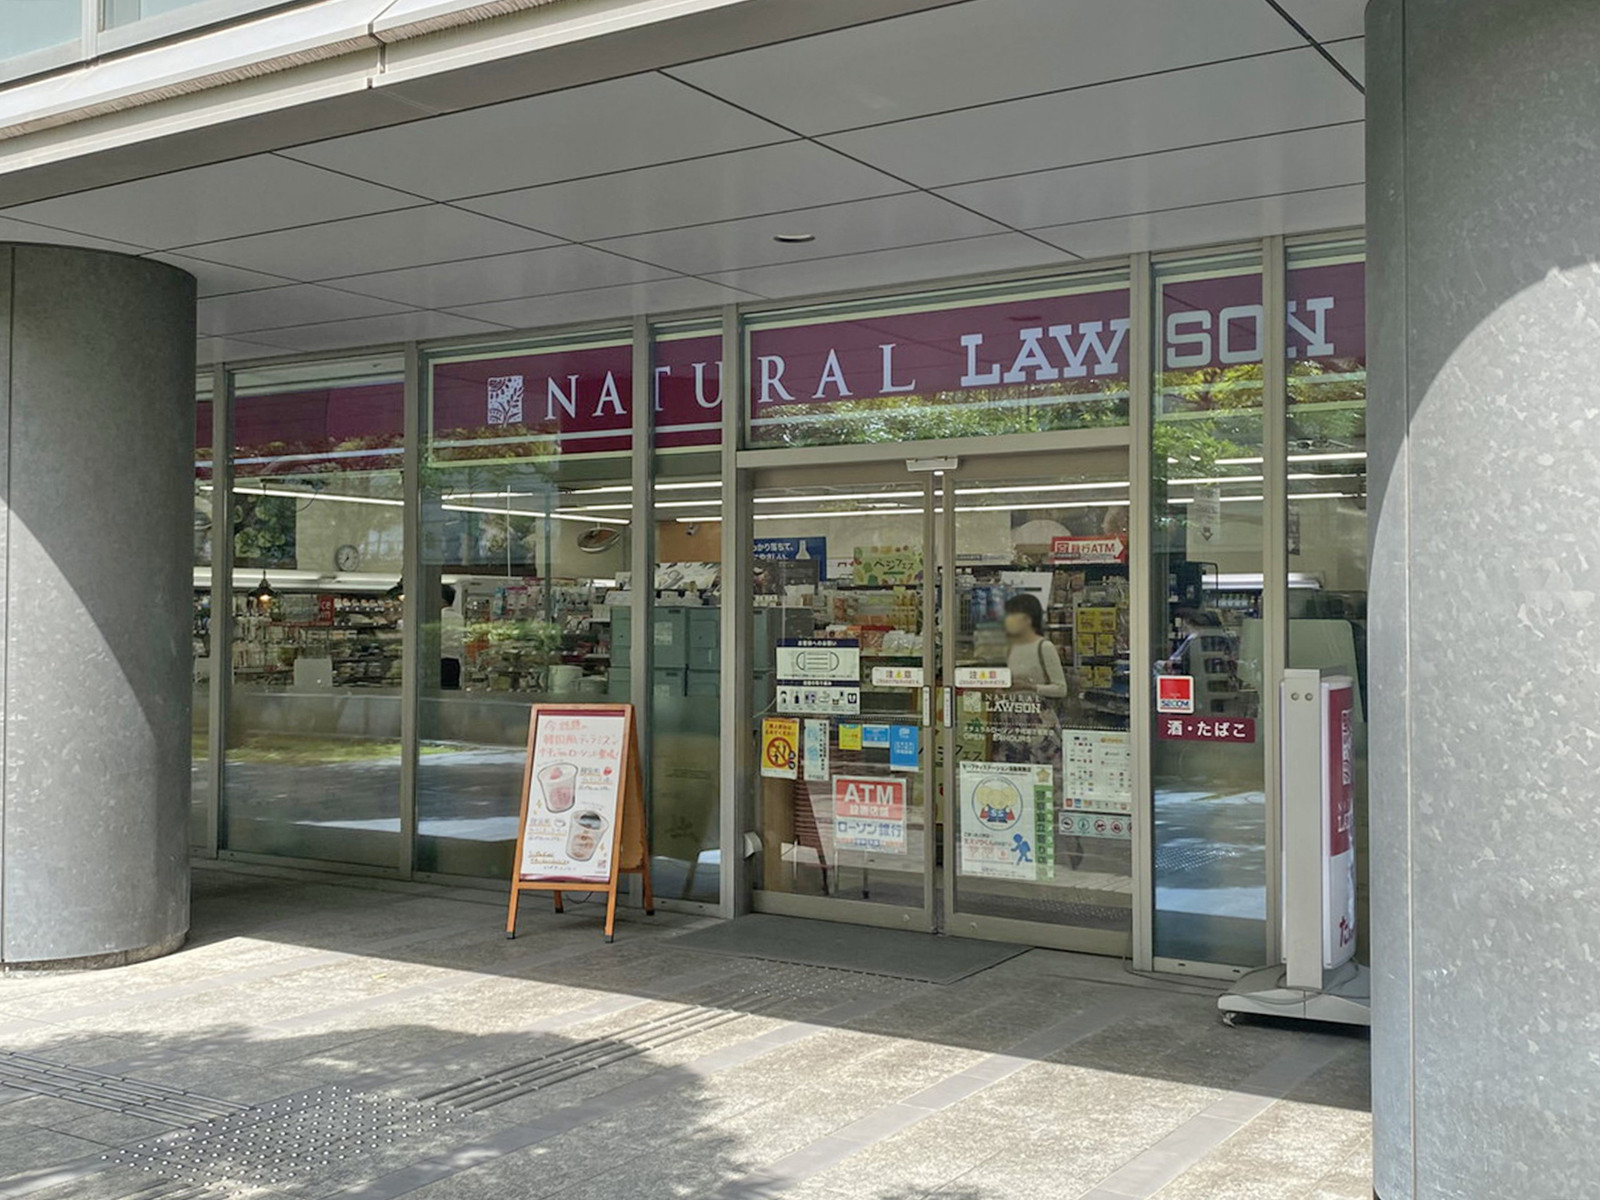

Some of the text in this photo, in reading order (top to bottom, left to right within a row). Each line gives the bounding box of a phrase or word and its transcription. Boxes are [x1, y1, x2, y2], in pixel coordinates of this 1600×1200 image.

[543, 296, 1335, 421] NATURAL LAWSON
[984, 692, 1041, 703] NATURAL
[1161, 700, 1190, 708] SECOM
[984, 701, 1042, 714] LAWSON
[1167, 720, 1246, 738] 酒・たばこ
[844, 783, 894, 806] ATM
[837, 821, 903, 838] ローソン銀行
